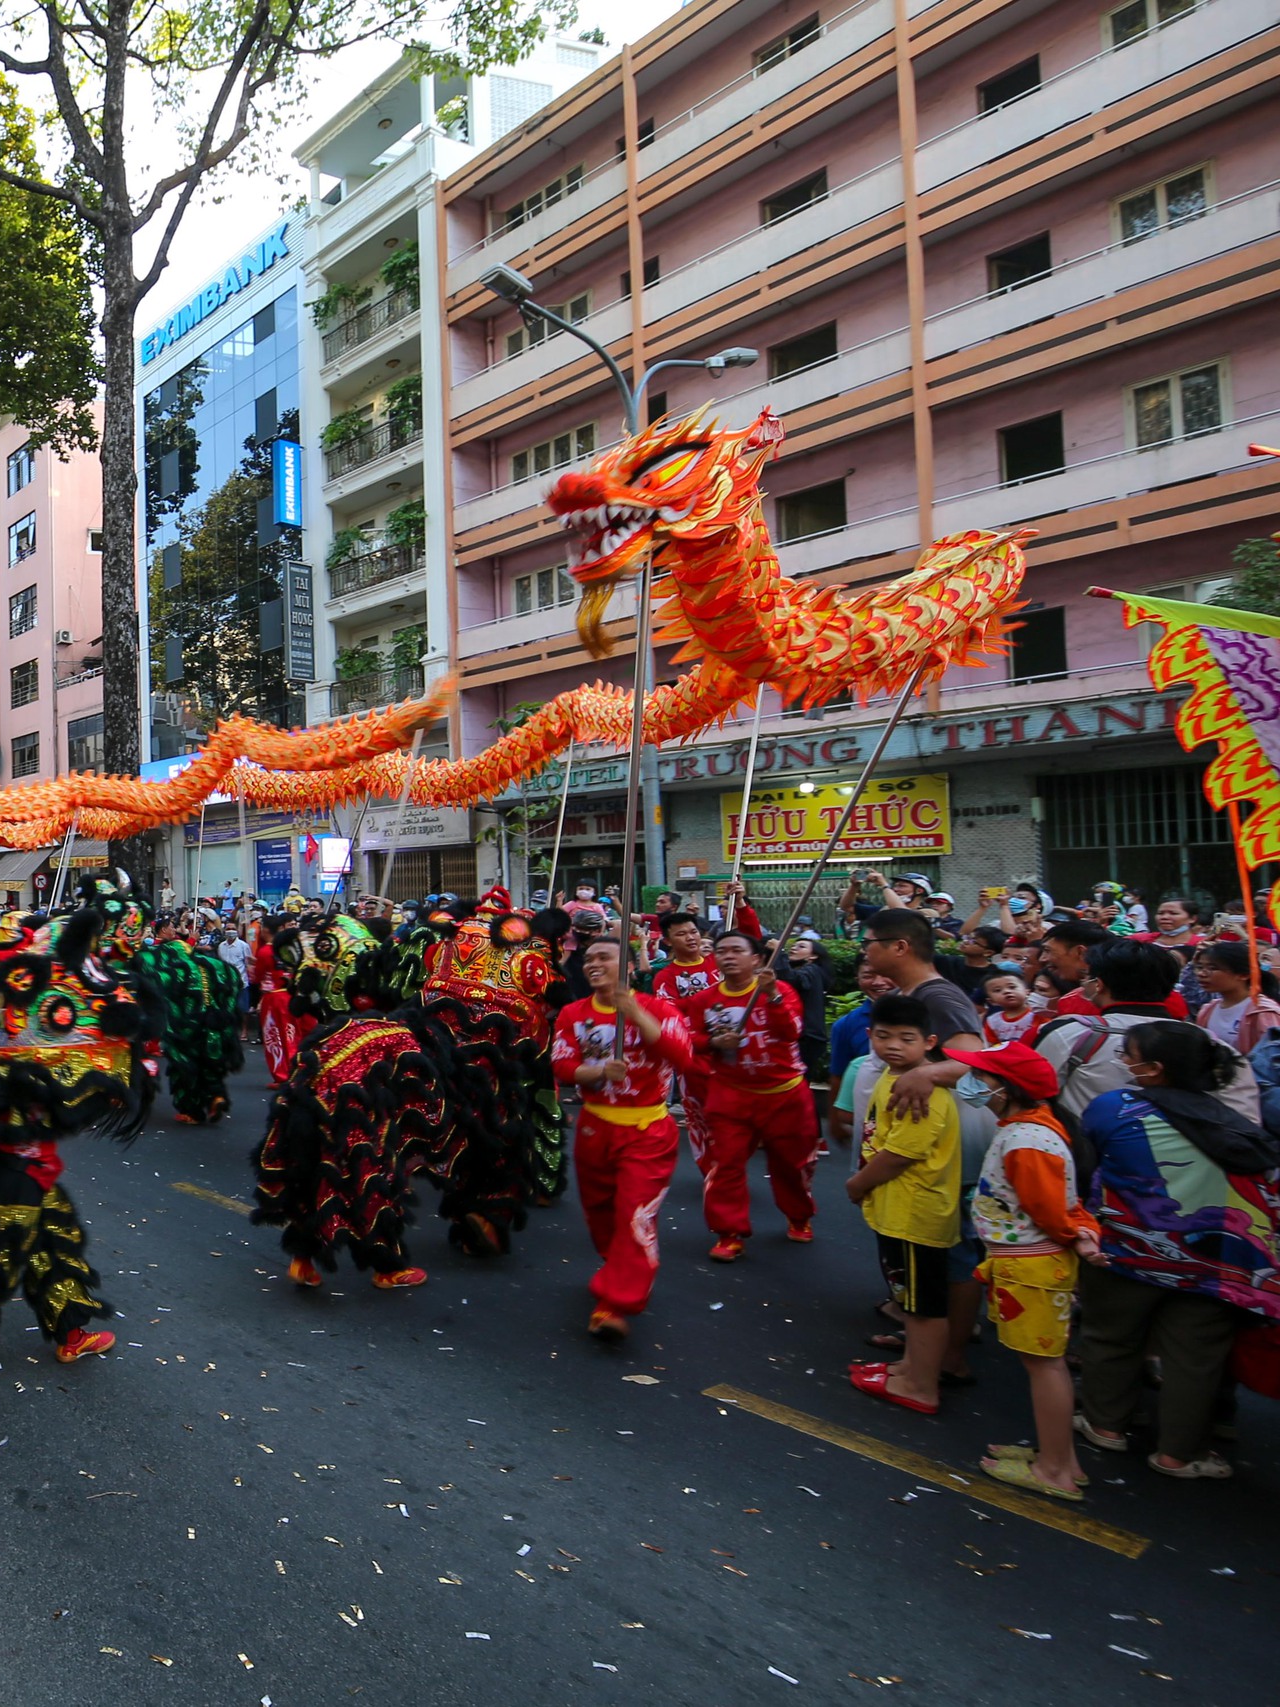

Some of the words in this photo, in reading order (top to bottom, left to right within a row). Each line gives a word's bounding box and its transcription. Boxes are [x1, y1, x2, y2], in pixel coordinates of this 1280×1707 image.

[141, 223, 289, 366] EXIMBANK
[285, 446, 295, 521] EXIMBANK
[295, 577, 309, 590] TAI
[291, 611, 313, 627] HỌNG
[728, 804, 807, 841] HỮU
[819, 794, 942, 836] THỨC
[765, 840, 787, 854] SỐ
[849, 835, 888, 849] CÁC
